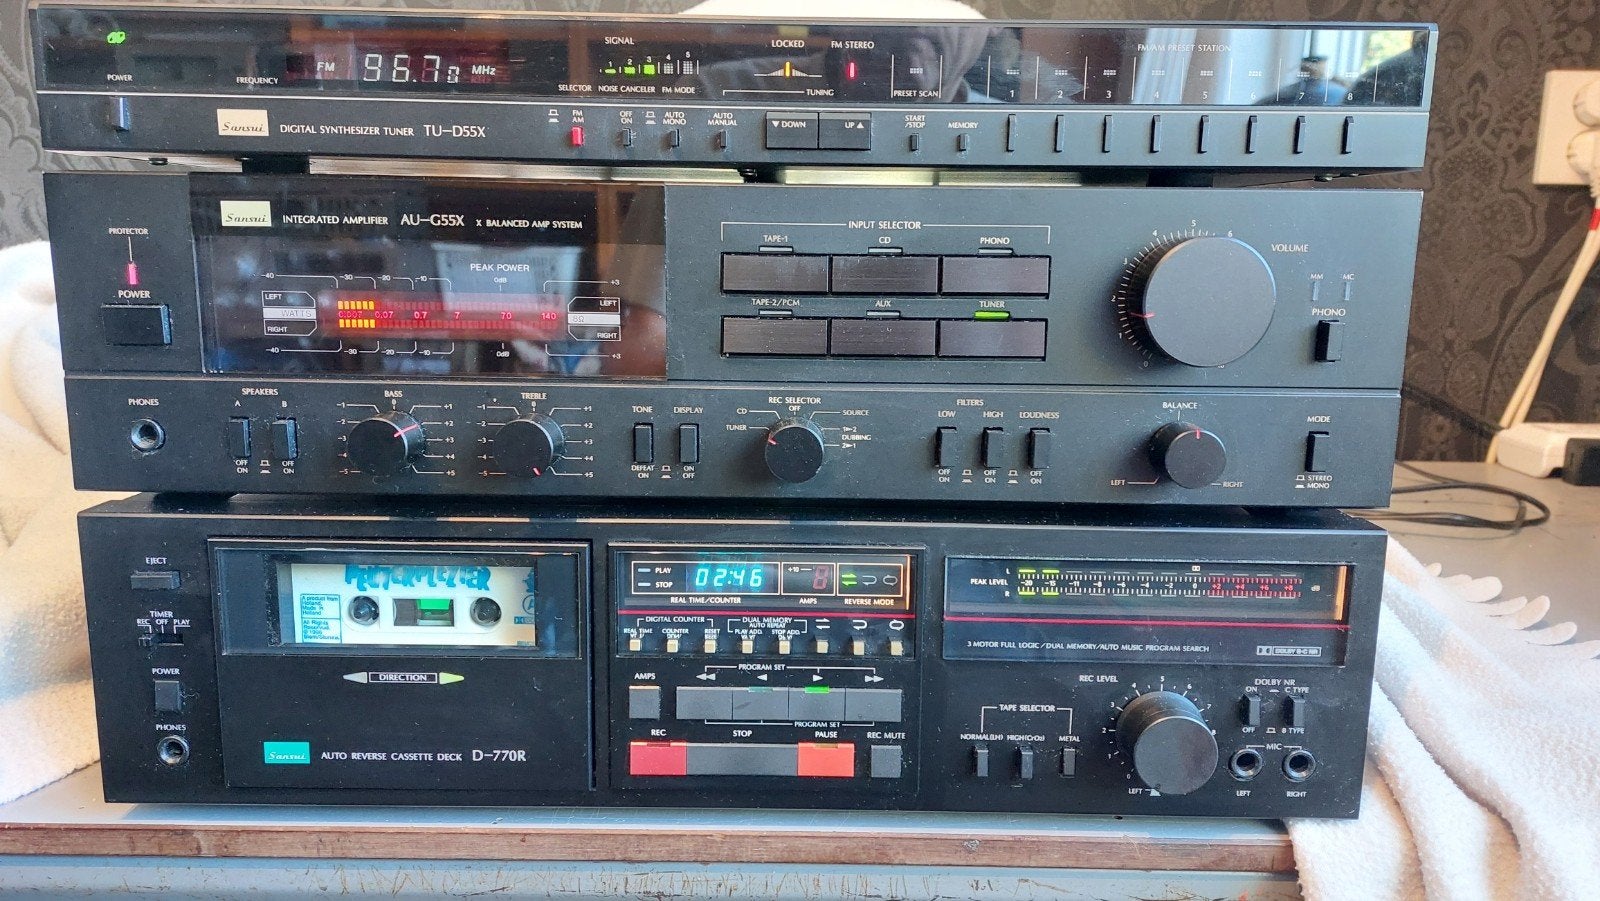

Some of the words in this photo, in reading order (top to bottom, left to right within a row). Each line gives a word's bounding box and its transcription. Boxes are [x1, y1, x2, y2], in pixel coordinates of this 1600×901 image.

[605, 37, 634, 45] SIGNAL
[845, 41, 874, 49] STEREO
[317, 63, 335, 72] FM
[472, 66, 495, 75] MHz
[222, 122, 265, 132] Sansui
[280, 124, 317, 134] DIGITAL
[320, 125, 379, 135] SYNTHESIZER
[383, 127, 414, 136] TUNER
[424, 125, 486, 137] TU-D55X
[226, 213, 268, 223] Sansui
[283, 215, 339, 224] INTEGRATED
[343, 217, 388, 225] AMPLIFIER
[848, 221, 874, 229] INPUT
[878, 221, 921, 230] SELECTOR
[980, 237, 1010, 245] PHONO
[1272, 244, 1308, 252] VOLUME
[979, 301, 1005, 309] TUNER
[1312, 308, 1345, 316] PHONO
[242, 388, 278, 396] SPEAKERS
[146, 557, 167, 565] EJECT
[696, 569, 762, 587] 02:46
[351, 753, 387, 761] REVERSE
[391, 753, 432, 761] CASSETTE
[437, 753, 462, 761] DECK
[472, 751, 526, 762] D-770R
